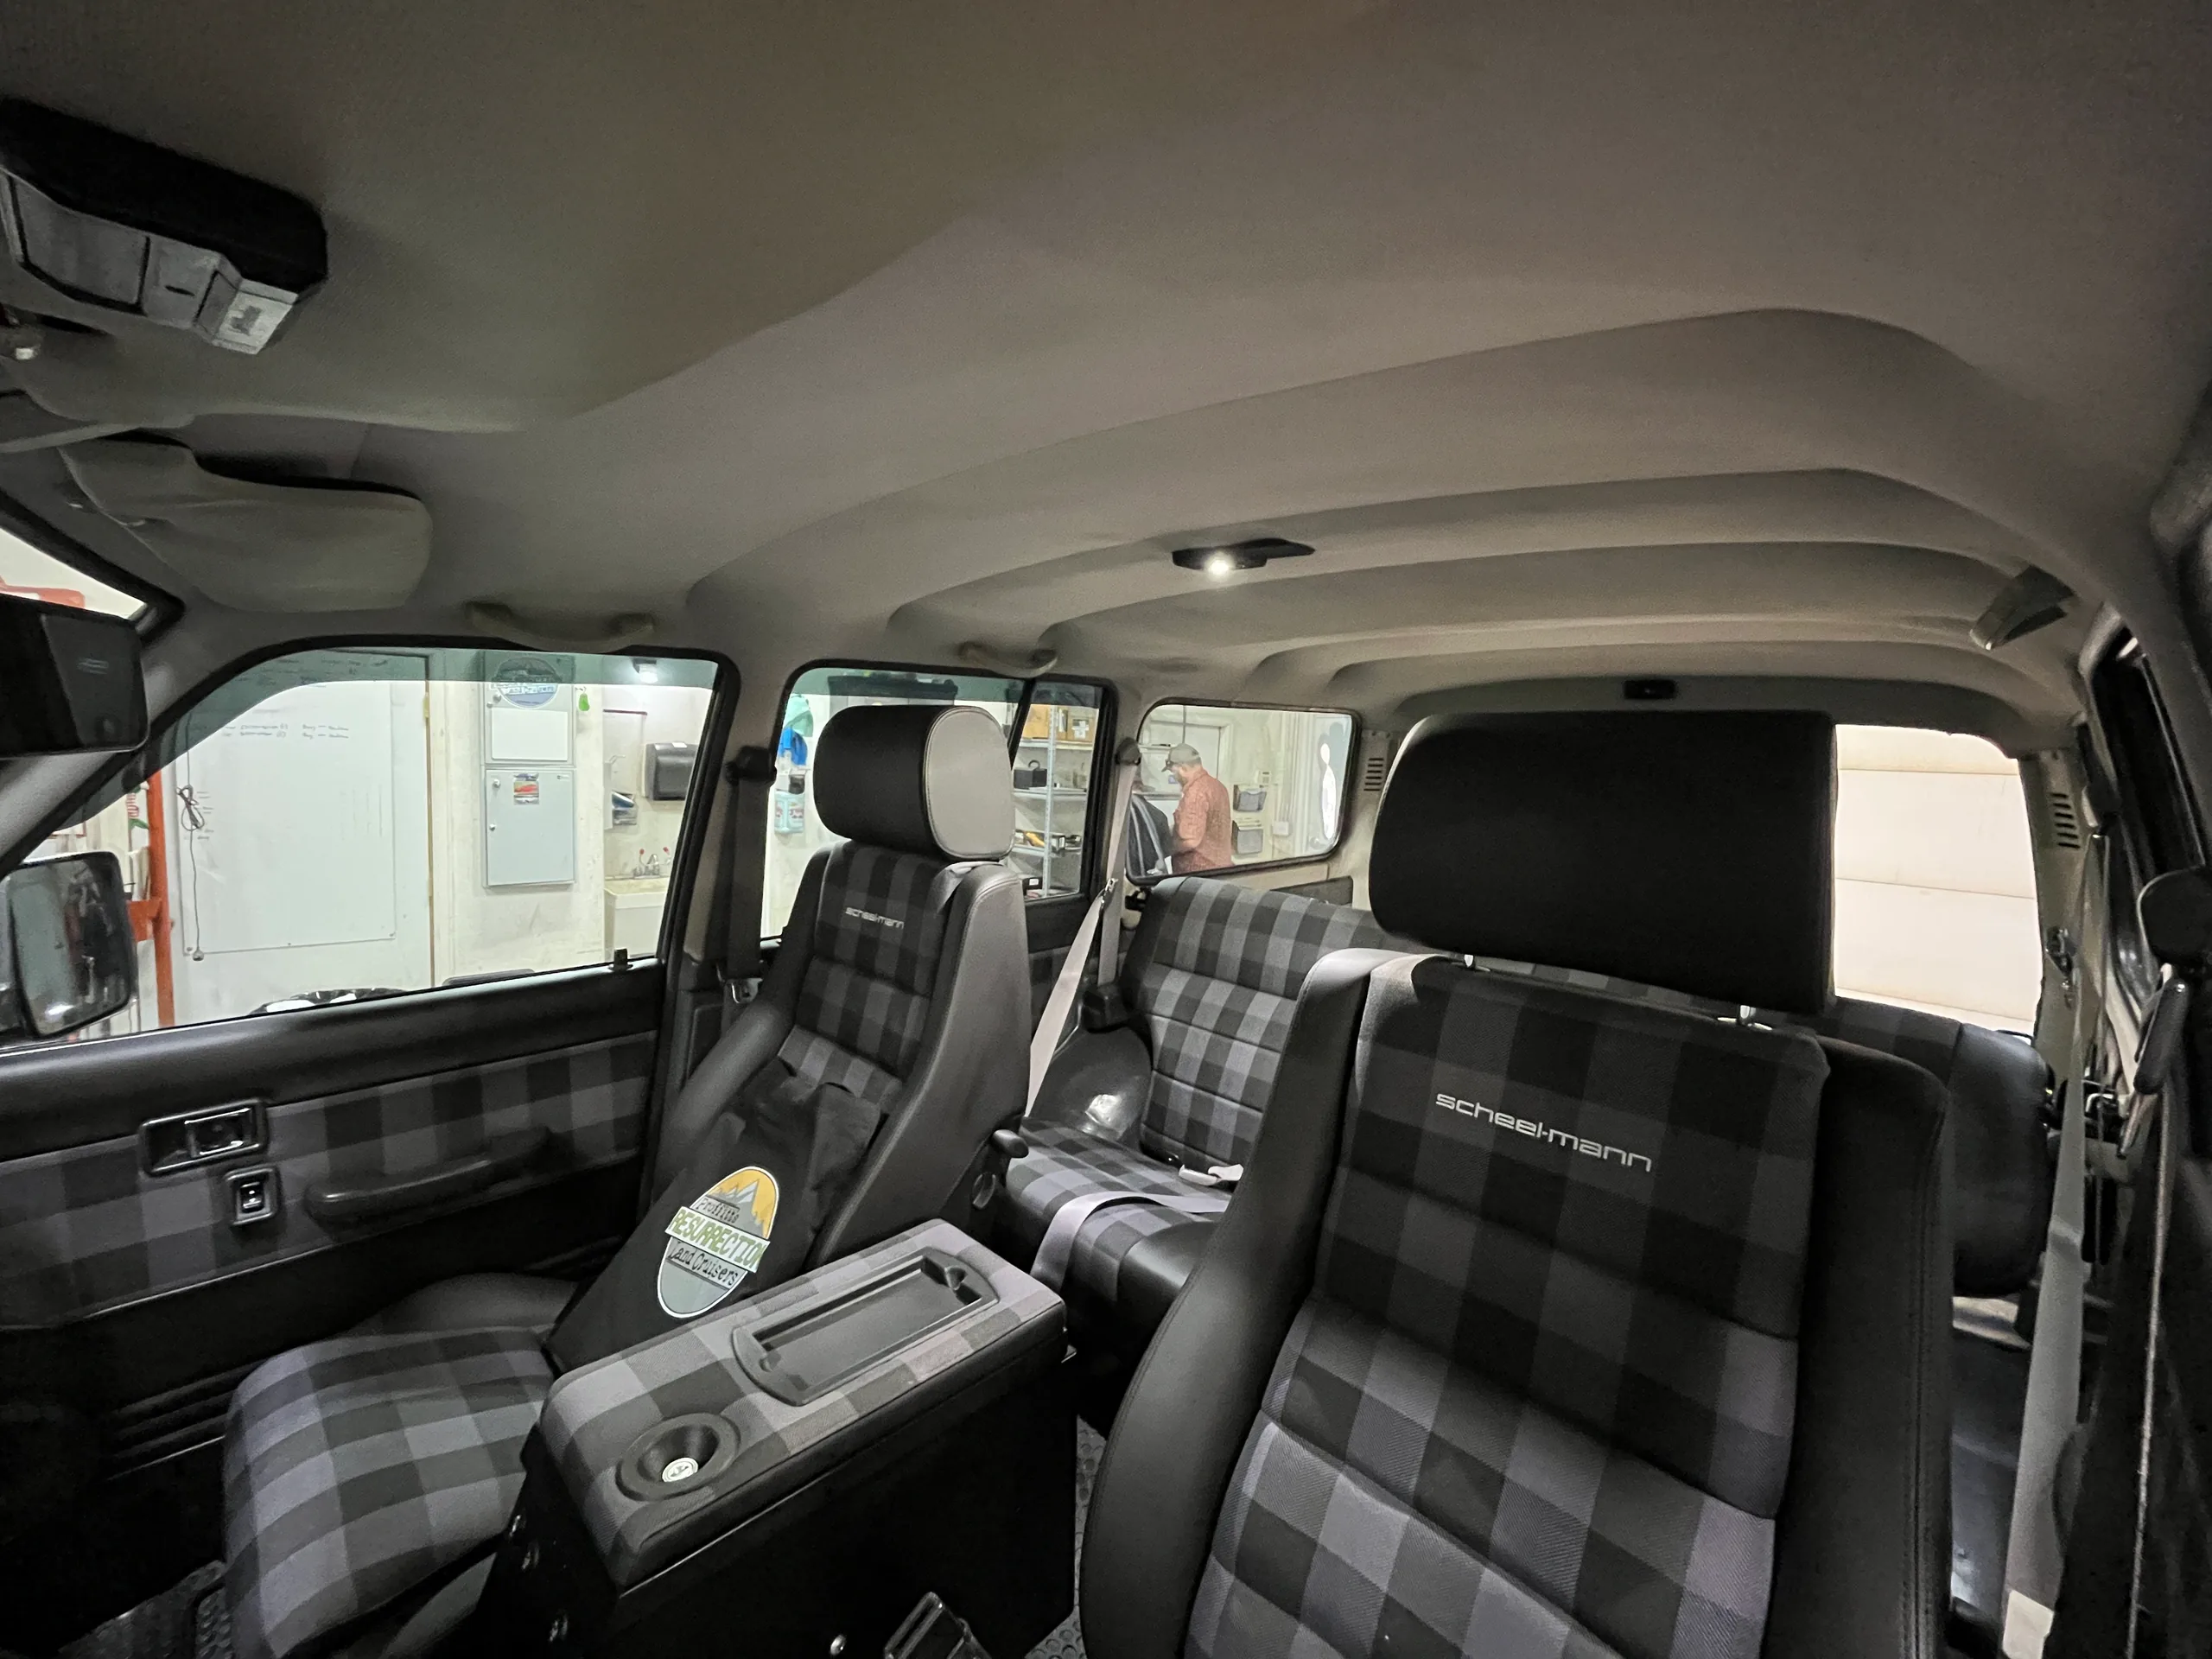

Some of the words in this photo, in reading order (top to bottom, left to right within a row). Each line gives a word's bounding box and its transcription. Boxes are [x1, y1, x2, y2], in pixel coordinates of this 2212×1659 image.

[1435, 1093, 1652, 1173] scheel-mann
[667, 1241, 696, 1265] Land
[691, 1253, 739, 1286] Cruisers
